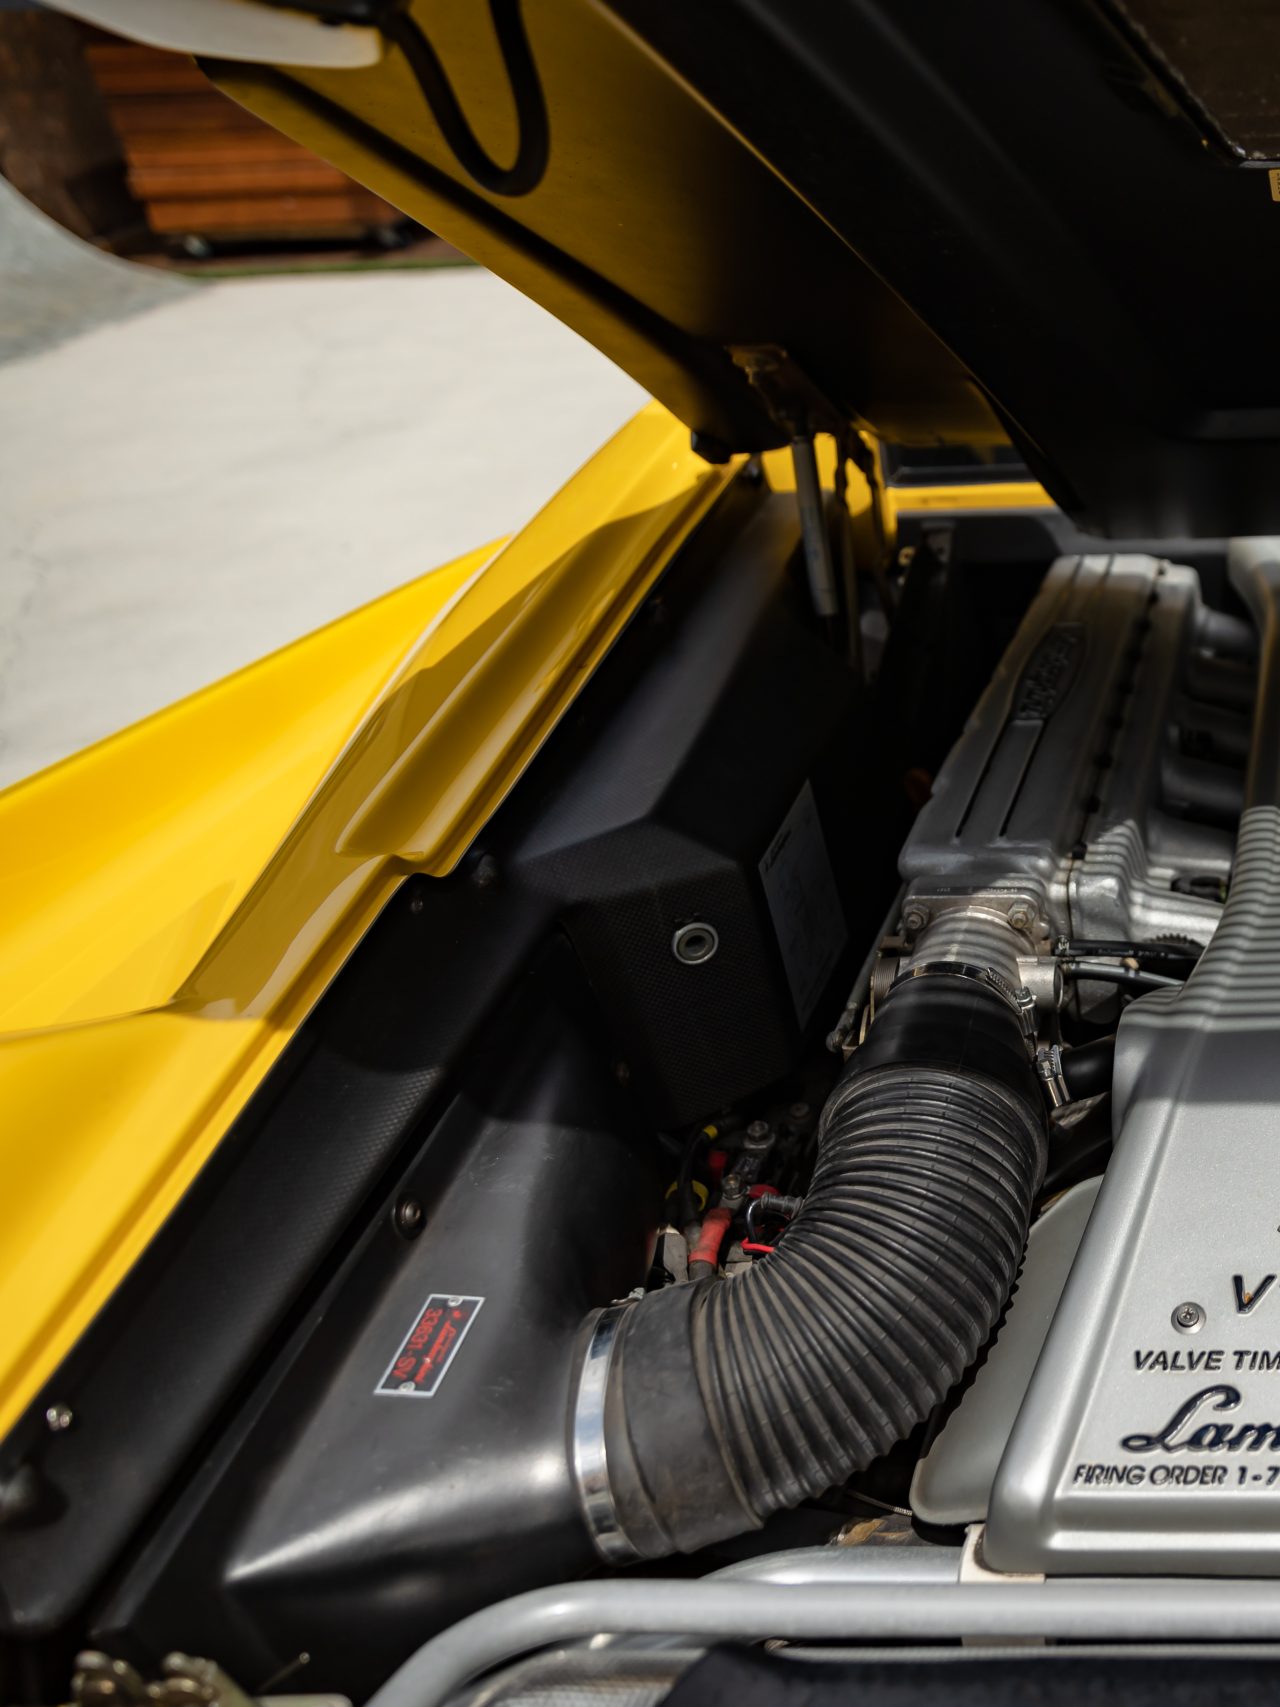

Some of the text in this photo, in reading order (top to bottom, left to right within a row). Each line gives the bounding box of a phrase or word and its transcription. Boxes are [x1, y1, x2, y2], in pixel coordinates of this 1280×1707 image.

[1134, 1350, 1226, 1372] VALVE
[1073, 1464, 1145, 1486] FIRING
[1148, 1464, 1228, 1486] ORDER
